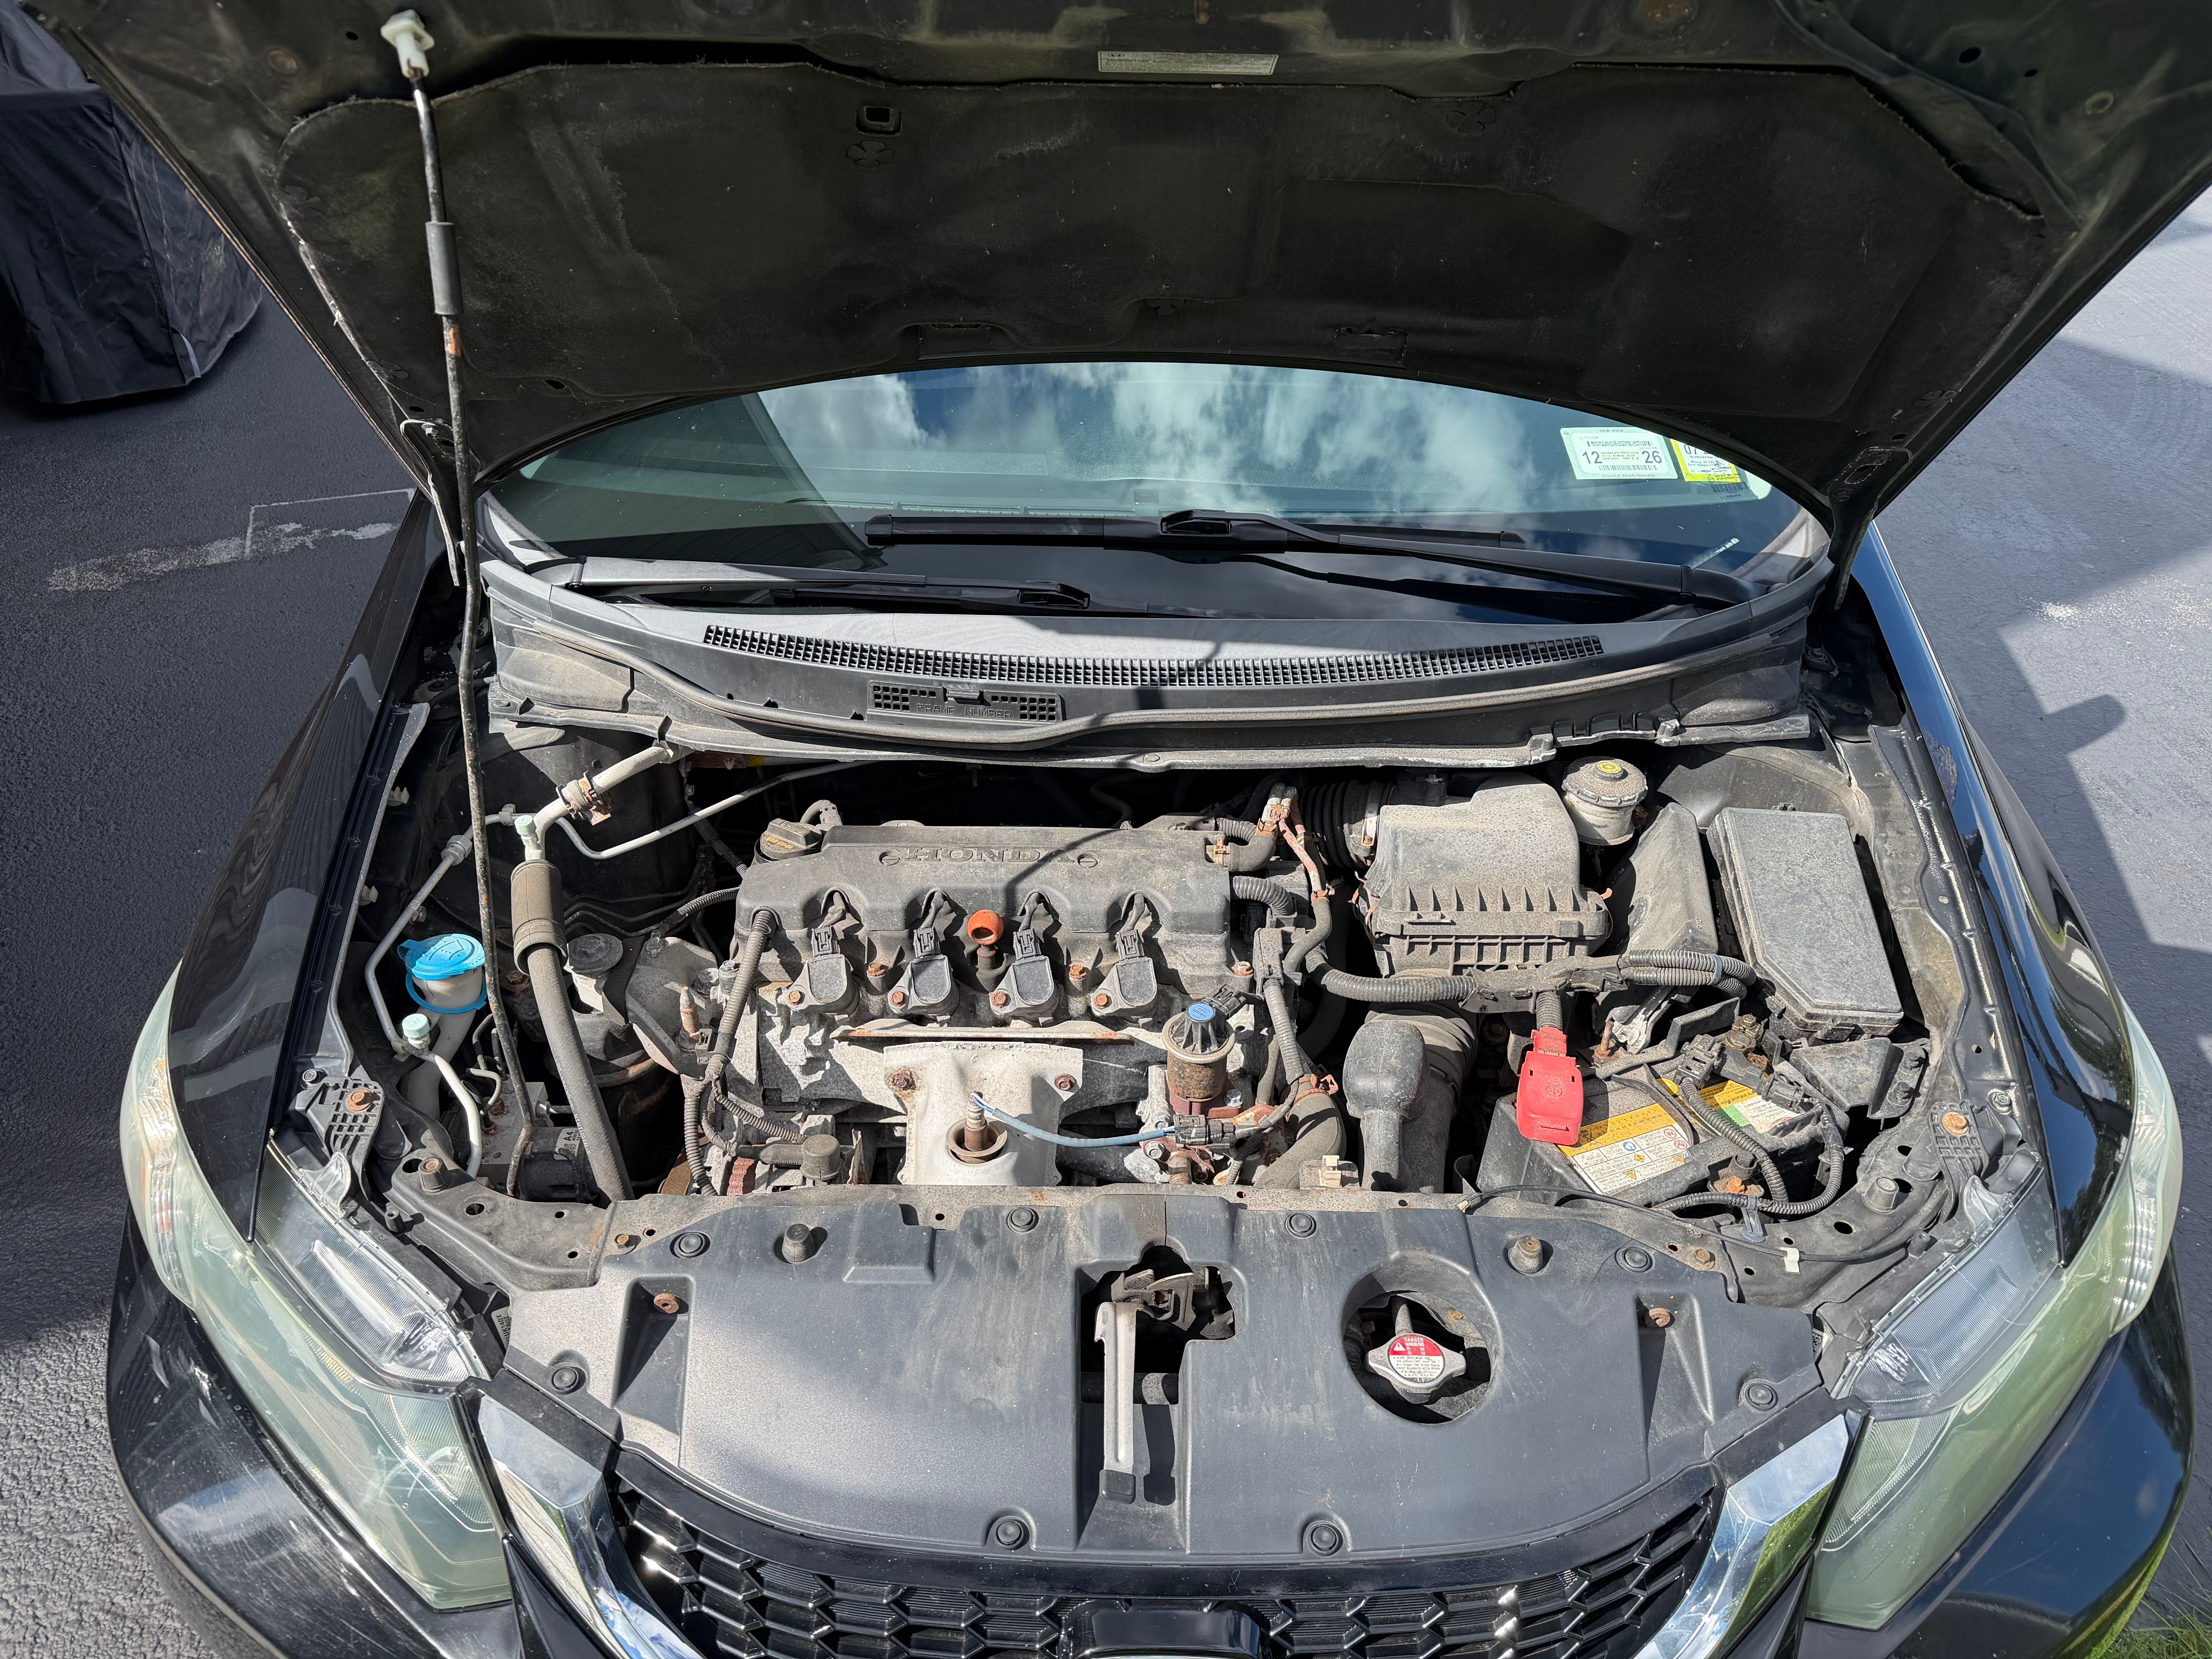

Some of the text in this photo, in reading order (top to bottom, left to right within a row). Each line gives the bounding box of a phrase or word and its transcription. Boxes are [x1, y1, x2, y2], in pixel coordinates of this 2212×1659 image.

[1583, 451, 1602, 464] 12
[1642, 451, 1662, 464] 26
[917, 703, 1012, 719] FRAME NUMBER
[905, 847, 1075, 863] HONDA
